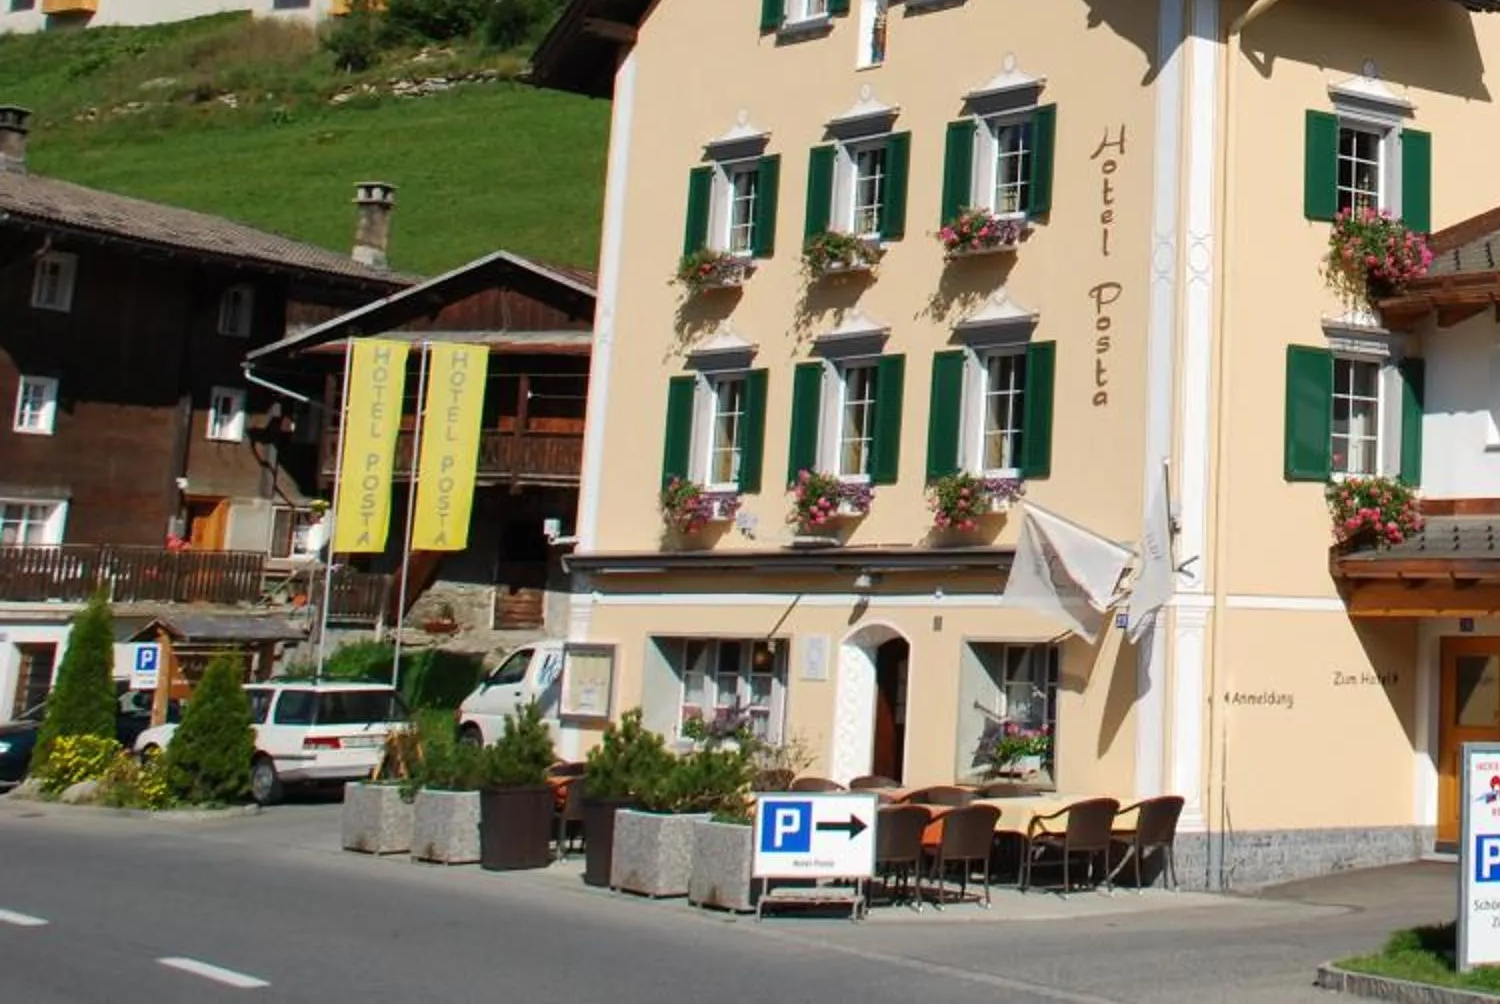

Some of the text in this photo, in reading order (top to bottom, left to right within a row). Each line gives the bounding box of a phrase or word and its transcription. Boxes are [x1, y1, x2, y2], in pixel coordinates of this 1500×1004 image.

[1088, 124, 1126, 406] Hotel Posta
[356, 347, 390, 546] HOTEL POSTA
[434, 352, 468, 545] HOTEL POSTA
[141, 649, 153, 669] P
[1332, 671, 1357, 686] Zum
[1231, 691, 1295, 709] Anmeldung
[774, 808, 801, 848] P
